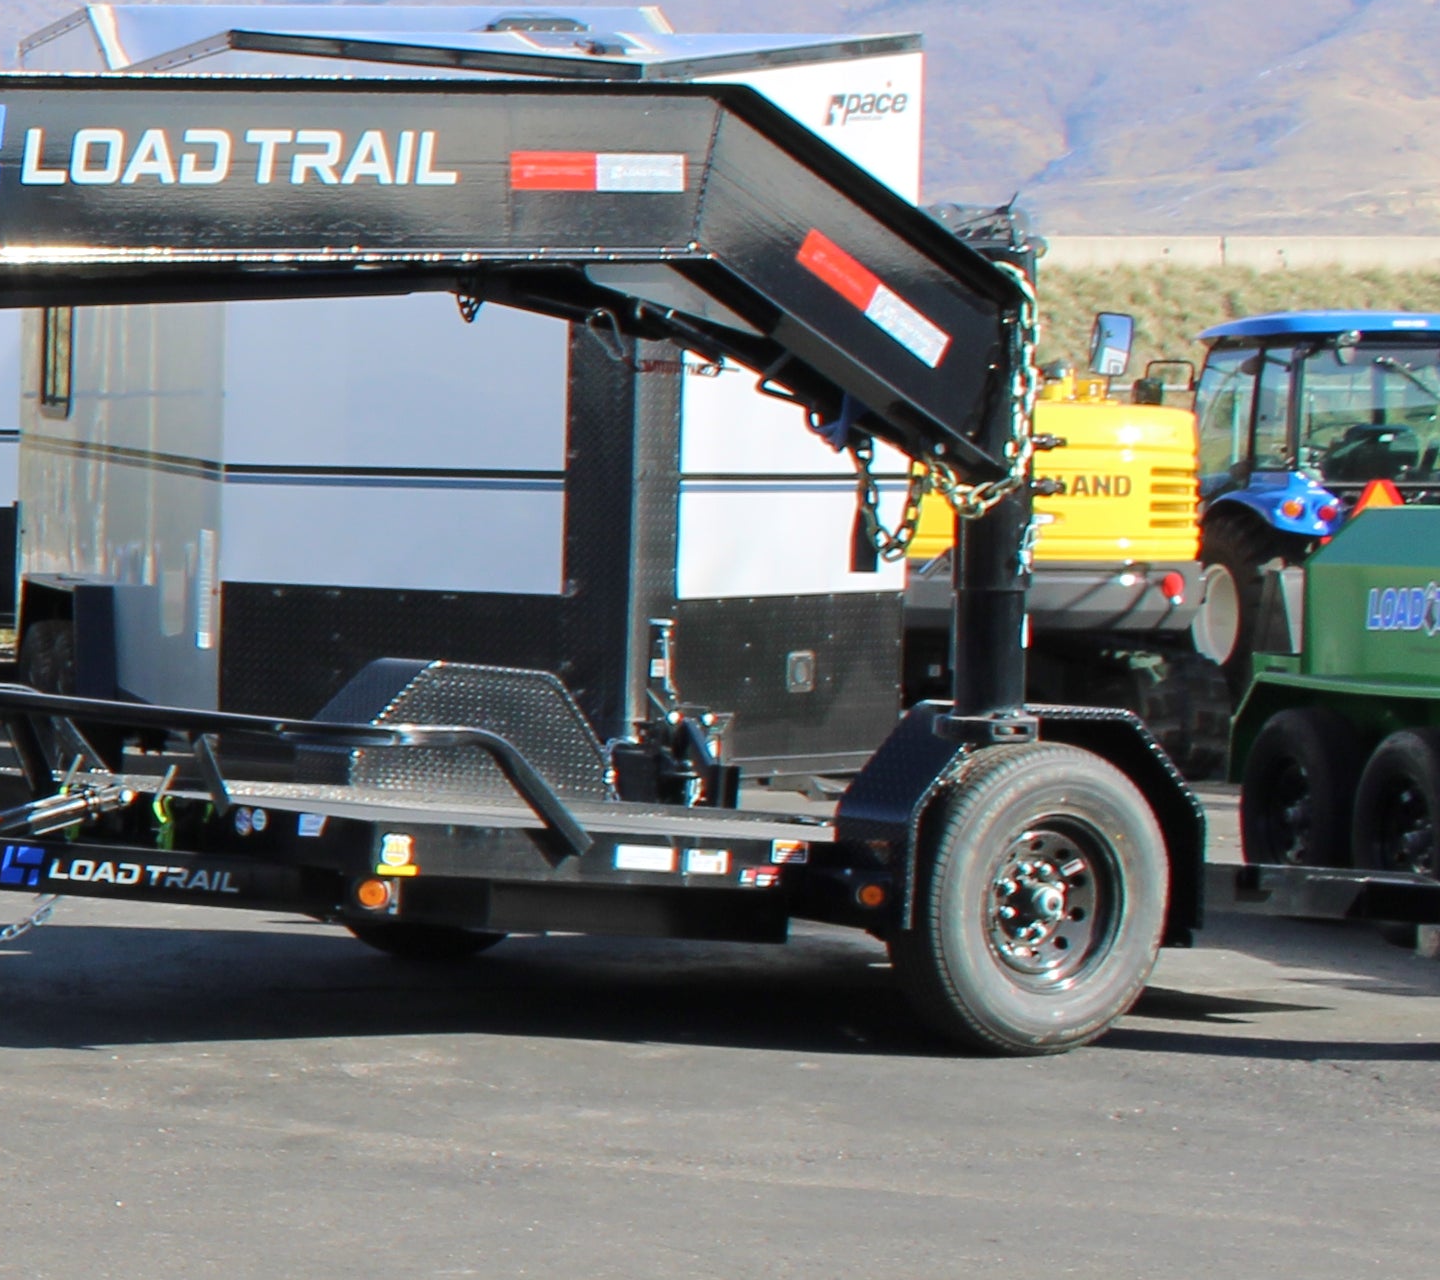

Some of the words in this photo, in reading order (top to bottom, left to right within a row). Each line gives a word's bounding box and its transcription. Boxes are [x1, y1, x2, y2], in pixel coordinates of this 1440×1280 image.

[21, 128, 233, 186] LOAD
[245, 129, 461, 186] TRAIL
[1366, 587, 1425, 631] LOAD
[48, 858, 143, 885] LOAD
[146, 864, 240, 894] TRAIL
